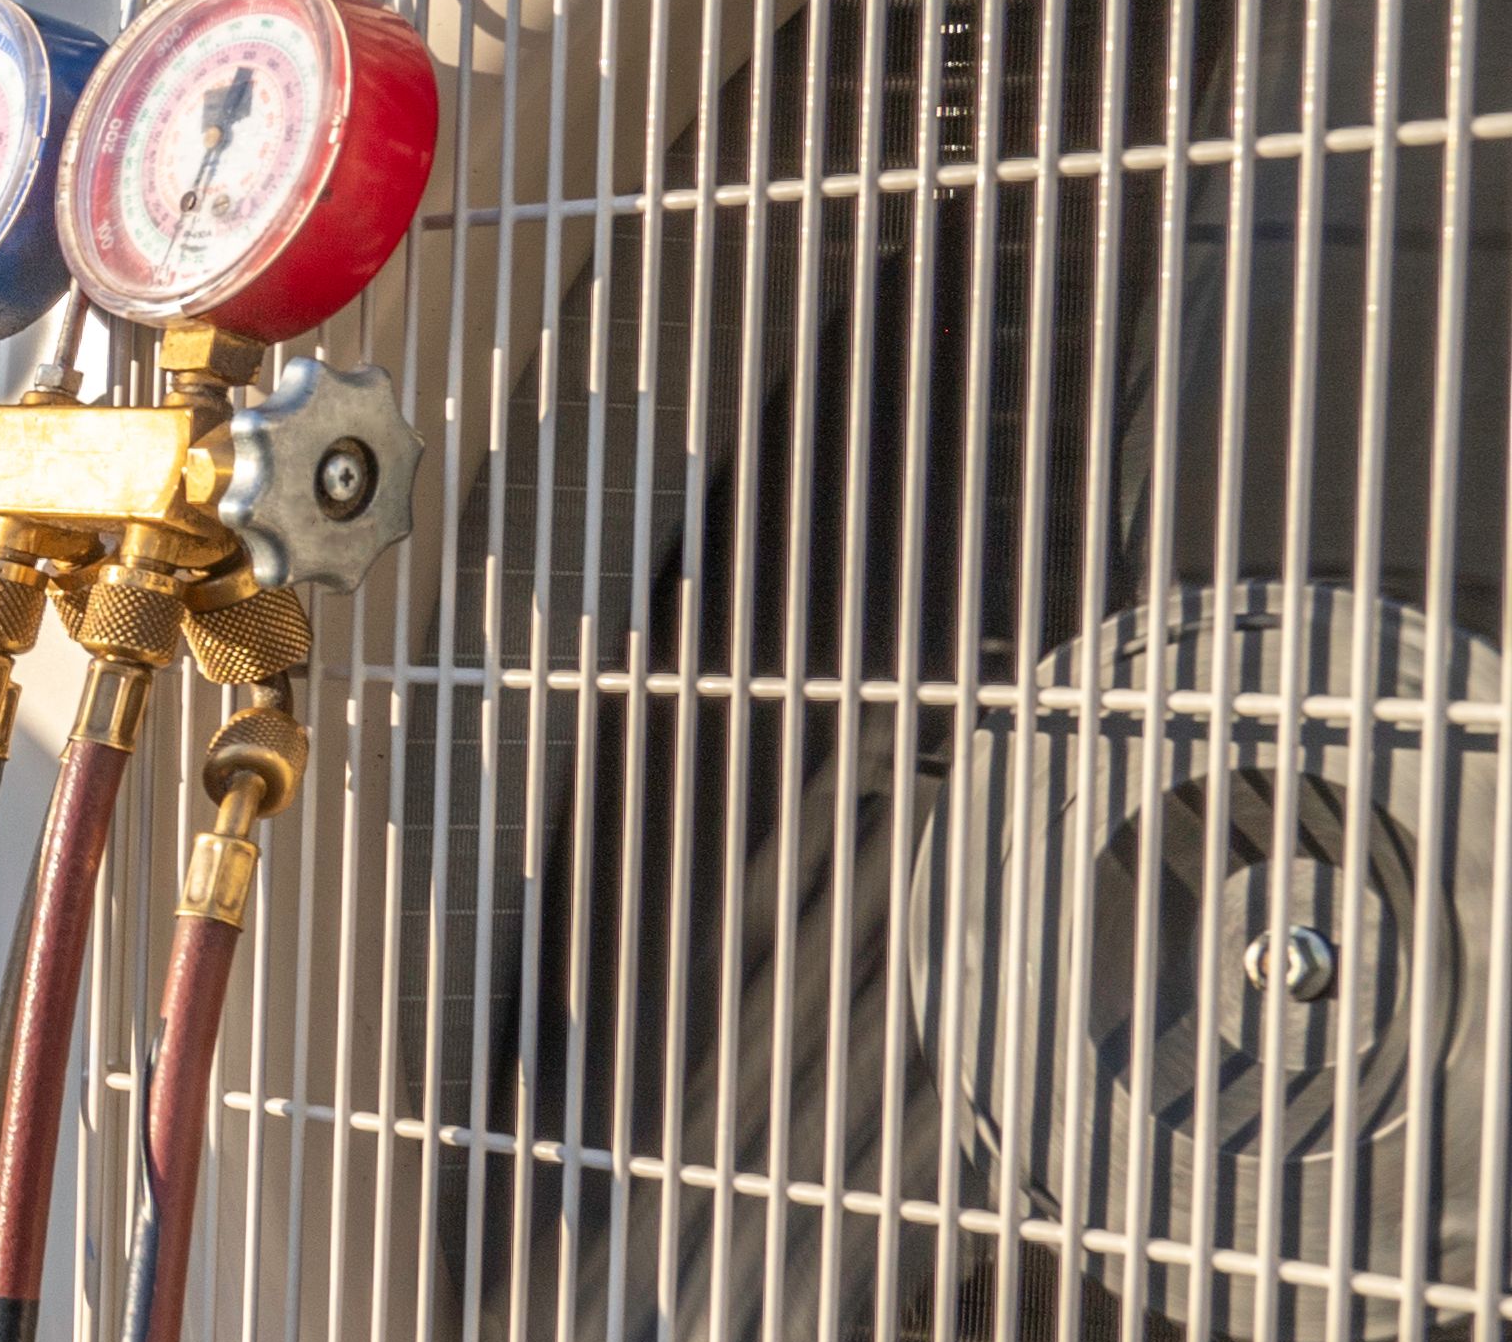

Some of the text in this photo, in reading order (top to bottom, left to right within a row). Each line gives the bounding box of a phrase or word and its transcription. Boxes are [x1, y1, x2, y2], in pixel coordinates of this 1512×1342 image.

[156, 23, 185, 59] 300
[101, 118, 124, 155] 200
[96, 221, 115, 251] 100
